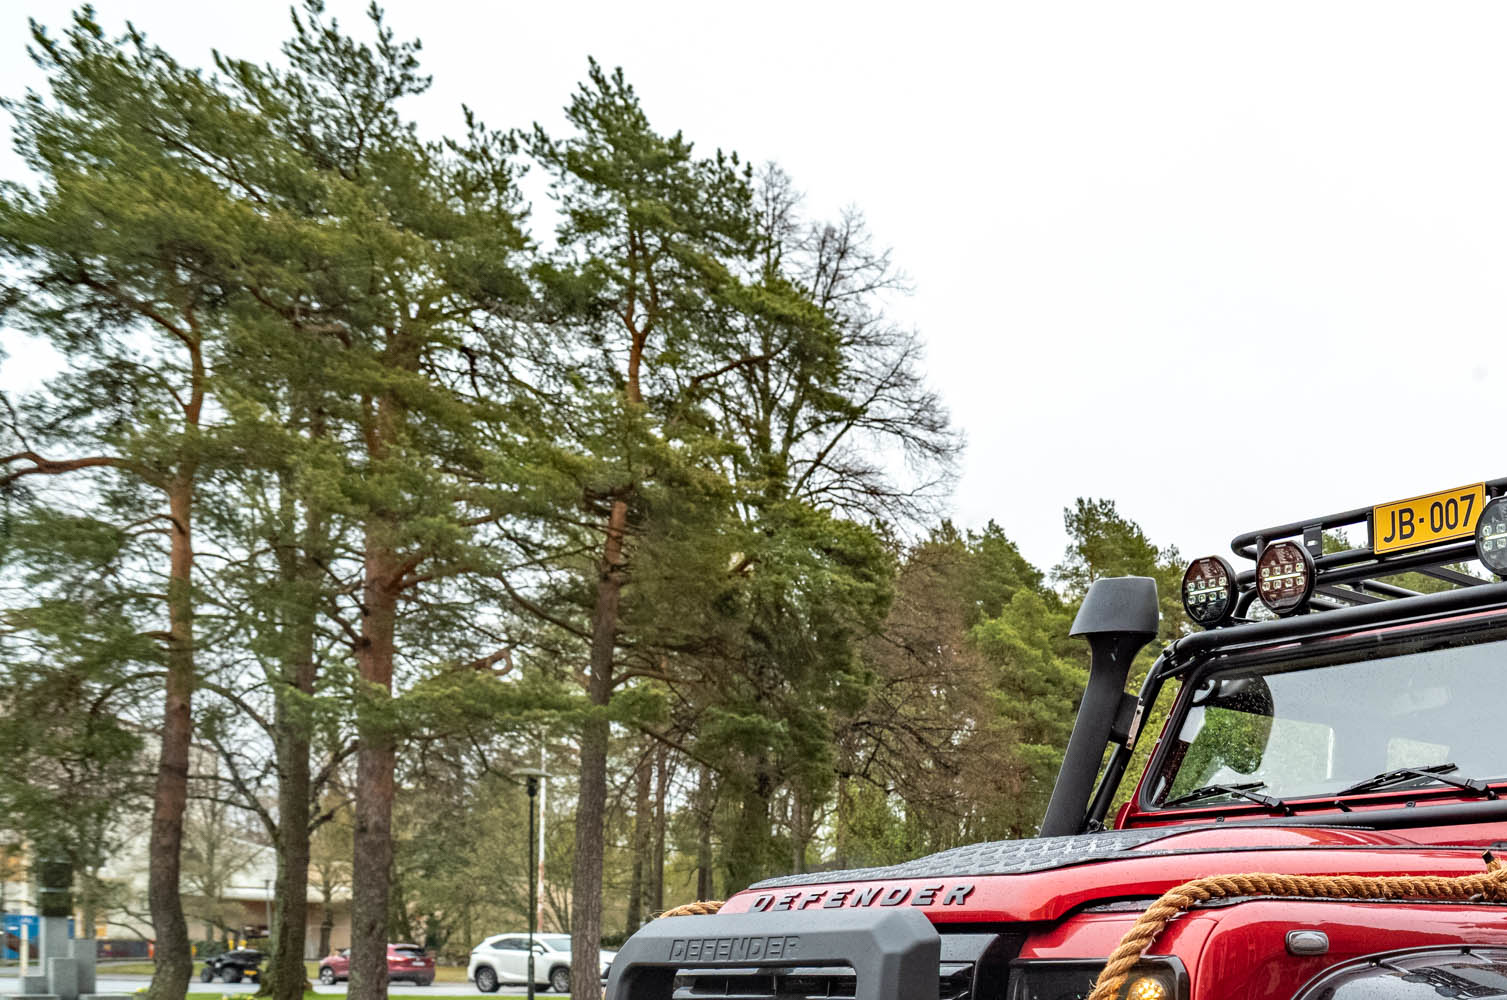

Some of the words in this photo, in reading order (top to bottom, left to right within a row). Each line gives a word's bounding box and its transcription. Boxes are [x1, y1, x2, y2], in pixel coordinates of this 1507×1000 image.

[1384, 494, 1476, 543] JB-007
[749, 885, 975, 912] DEFENDER
[670, 935, 800, 961] DEFENDER
